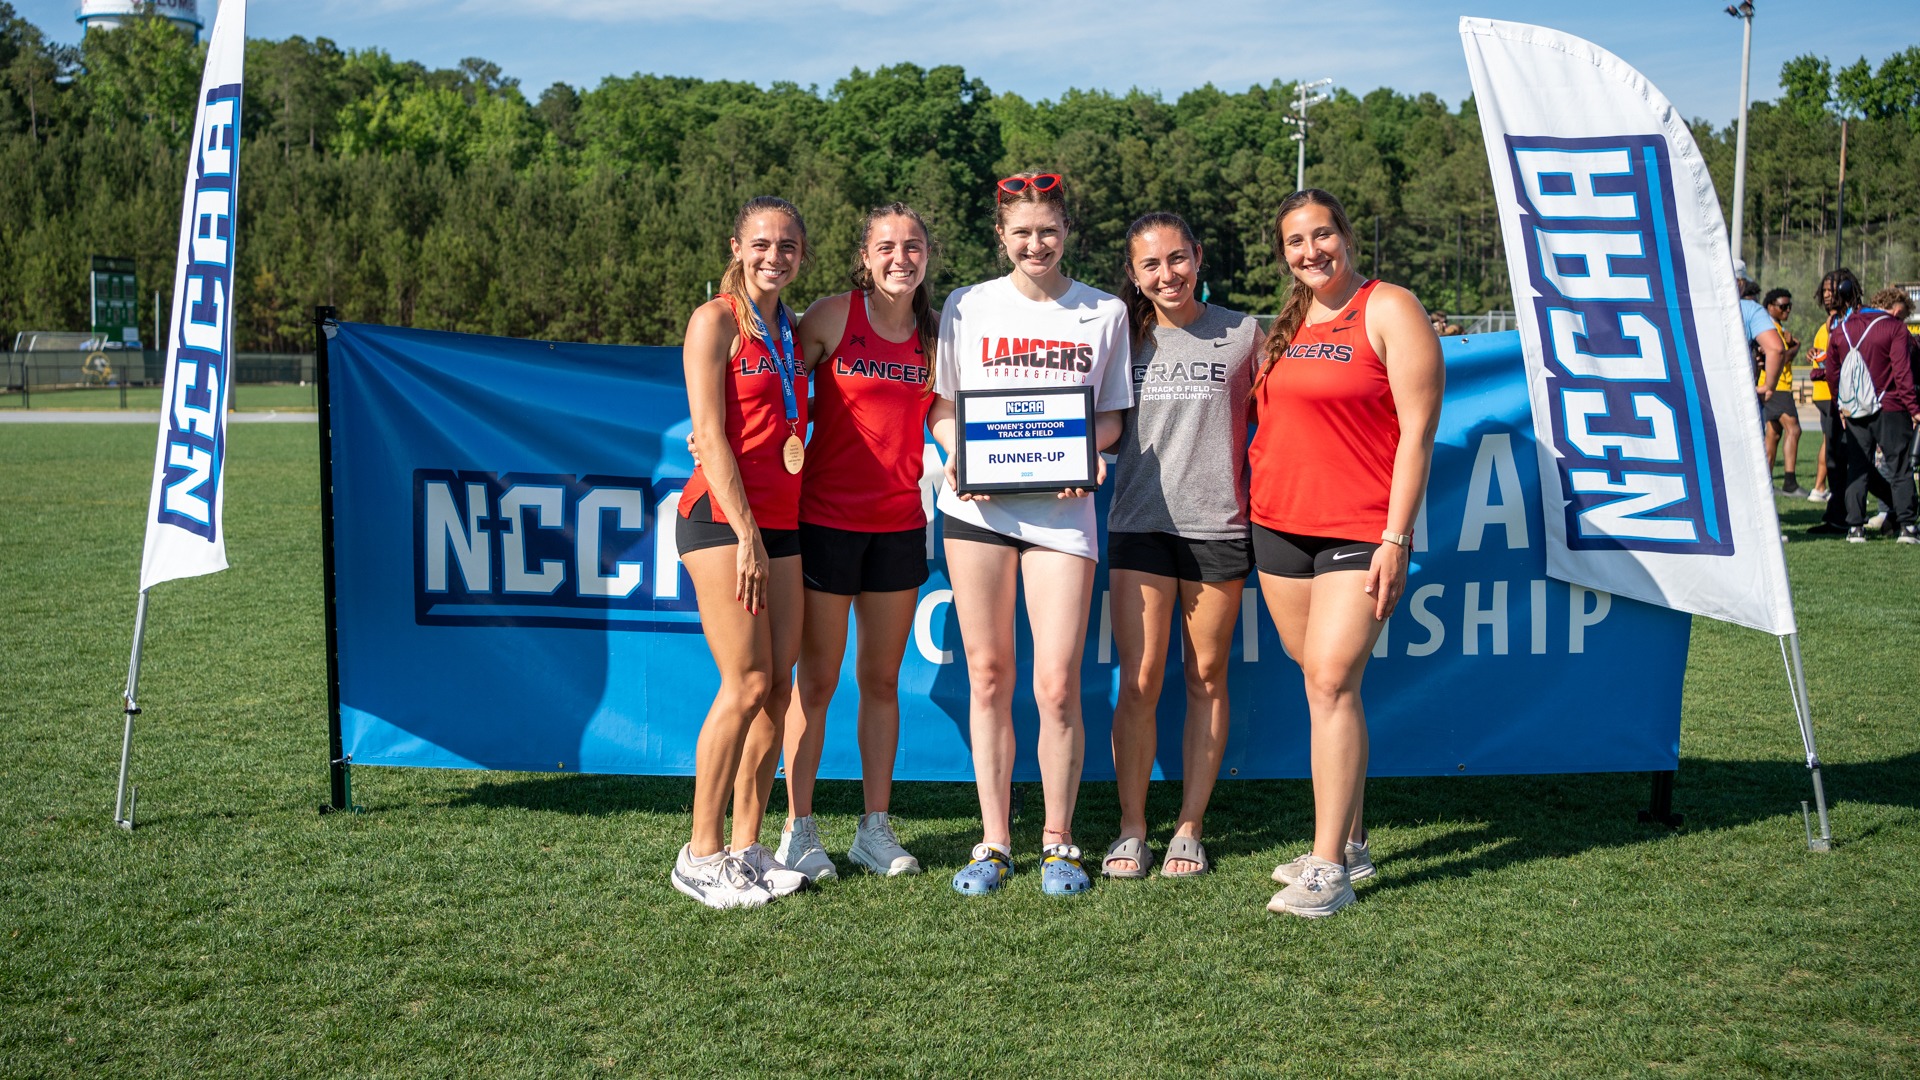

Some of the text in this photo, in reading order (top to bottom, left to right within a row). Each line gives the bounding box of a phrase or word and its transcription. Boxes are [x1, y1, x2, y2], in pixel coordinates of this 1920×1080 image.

[164, 97, 236, 527] NCCAA
[982, 337, 1093, 374] LANCERS
[1285, 342, 1354, 363] NCERS
[1513, 147, 1700, 543] NCCAA
[836, 357, 930, 385] LANCER
[1131, 361, 1228, 384] GRACE
[1006, 400, 1044, 414] NCCAA
[987, 421, 1065, 431] WOMEN'S OUTDOOR
[988, 451, 1065, 464] RUNNER-UP
[424, 480, 684, 599] NCC
